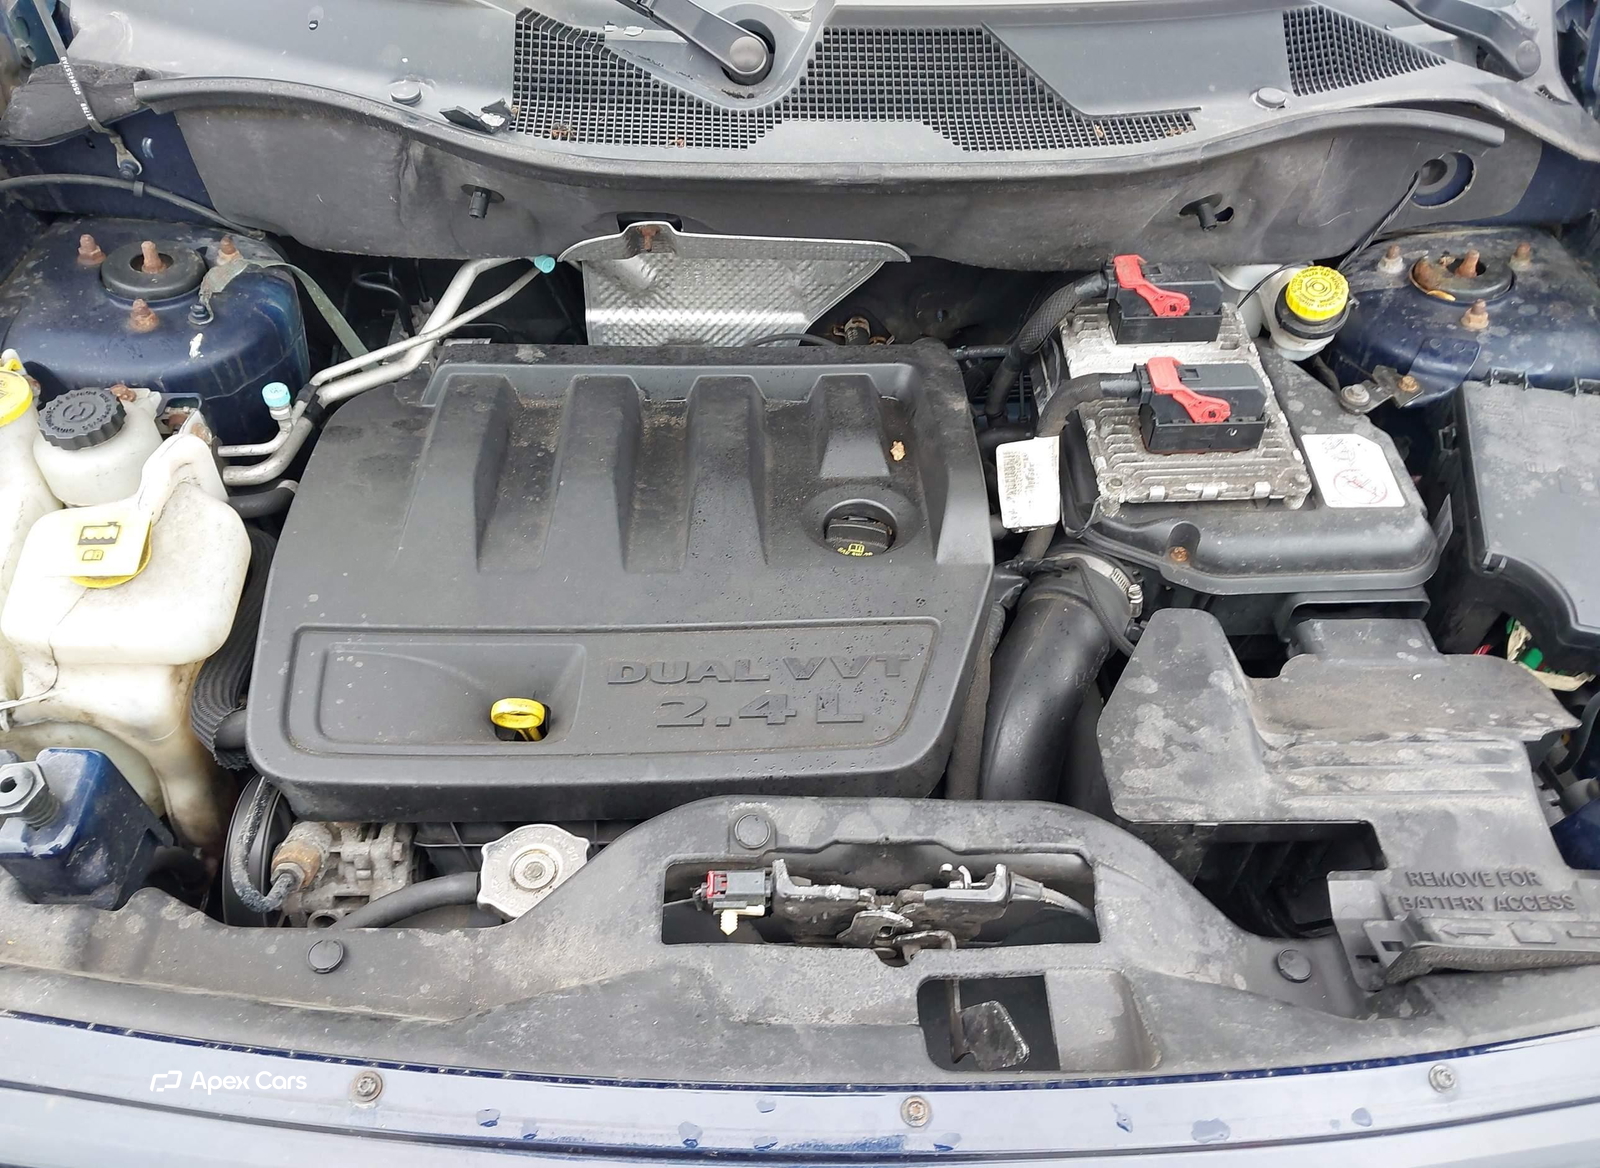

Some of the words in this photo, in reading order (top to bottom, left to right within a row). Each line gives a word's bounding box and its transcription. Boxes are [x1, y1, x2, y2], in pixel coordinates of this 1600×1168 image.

[607, 658, 771, 684] DUAL
[782, 654, 910, 681] VVT
[1405, 871, 1496, 888] REMOVE
[1497, 870, 1542, 887] FOR
[1398, 895, 1485, 912] BATTERY
[1494, 894, 1576, 912] ACCESS
